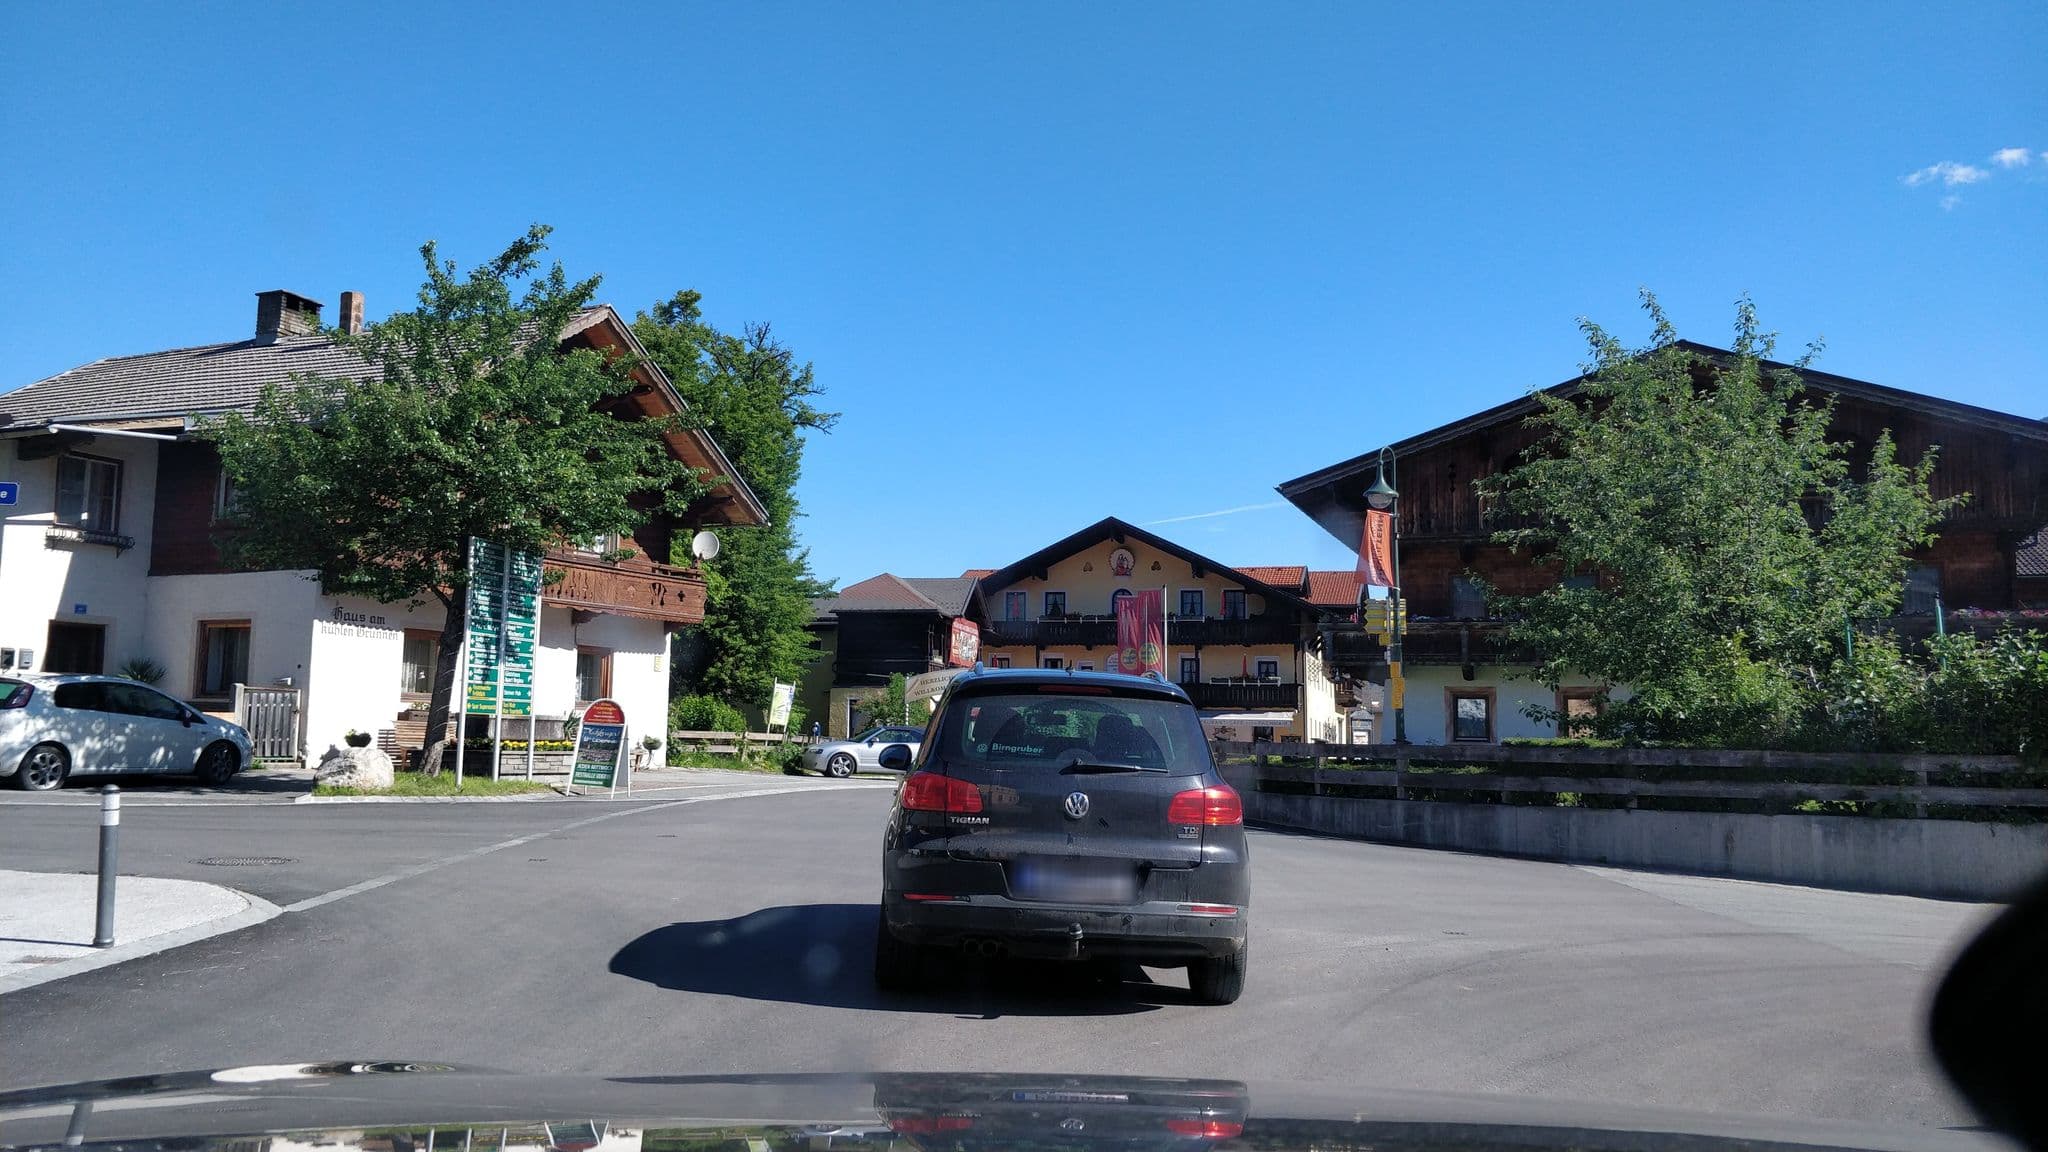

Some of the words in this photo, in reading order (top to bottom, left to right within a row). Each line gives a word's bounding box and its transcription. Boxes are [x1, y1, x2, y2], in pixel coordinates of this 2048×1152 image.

[332, 606, 366, 622] Haus
[369, 615, 386, 625] am
[914, 685, 946, 697] WILLKOM
[992, 742, 1042, 754] Birngruber
[950, 816, 990, 825] TIGUAN
